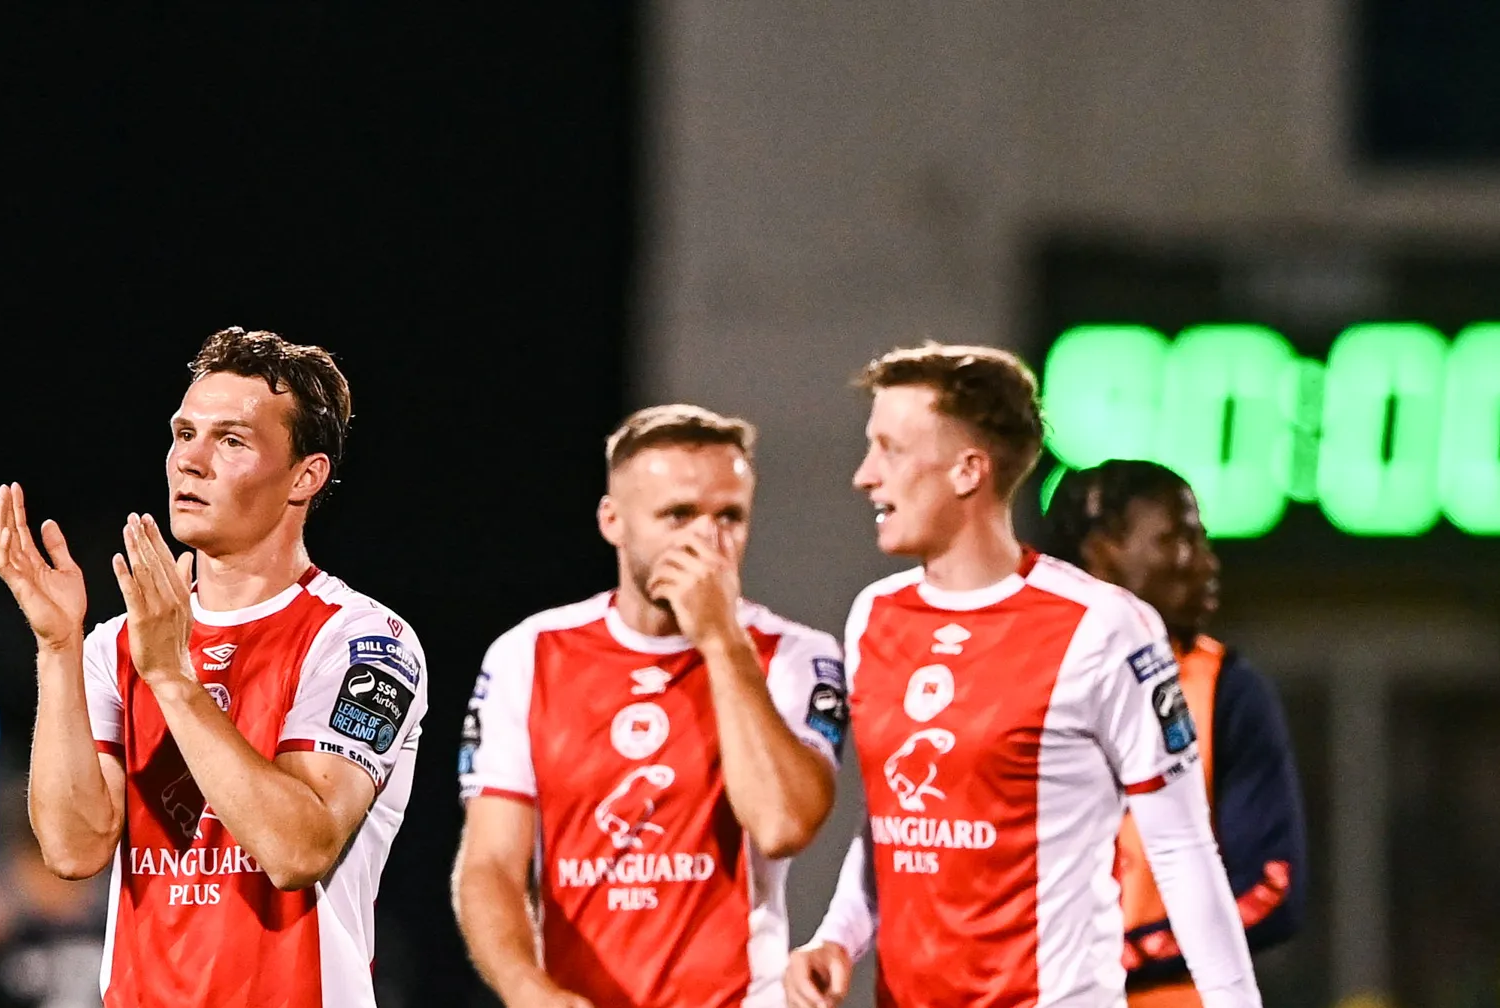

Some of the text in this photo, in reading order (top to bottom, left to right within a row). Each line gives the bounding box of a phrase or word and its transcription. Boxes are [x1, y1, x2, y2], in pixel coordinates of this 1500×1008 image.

[357, 641, 383, 652] BILL
[377, 681, 398, 699] sse
[332, 712, 376, 741] IRELAND
[337, 702, 382, 728] LEAGUE OF
[319, 741, 345, 755] THE
[893, 850, 940, 874] PLUS
[168, 883, 221, 906] PLUS
[607, 887, 659, 911] PLUS
